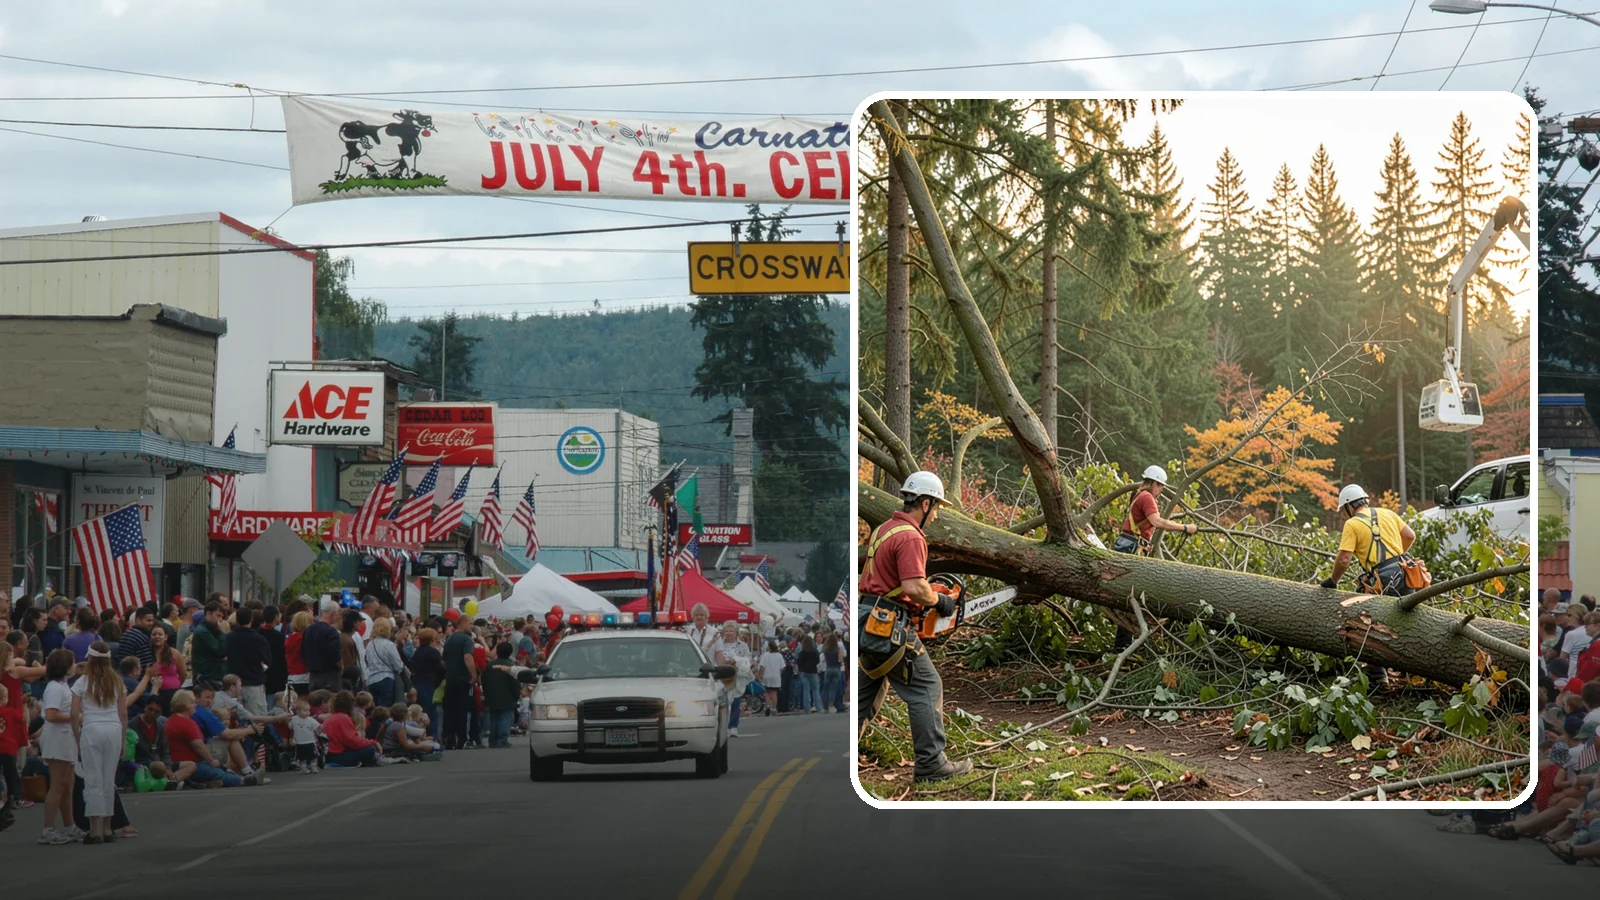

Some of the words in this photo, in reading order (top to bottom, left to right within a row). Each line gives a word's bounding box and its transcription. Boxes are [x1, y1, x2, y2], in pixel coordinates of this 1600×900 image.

[481, 141, 605, 192] JULY
[632, 150, 746, 197] 4th.
[697, 254, 850, 280] CROSSWA
[283, 380, 373, 420] ACE
[406, 409, 452, 422] CEDAR
[283, 421, 371, 437] Hardware
[354, 467, 386, 480] Simpl
[96, 485, 124, 494] Vincent
[126, 486, 136, 495] de
[138, 486, 155, 495] Paul
[688, 526, 741, 535] CRNATION
[699, 535, 730, 543] GLASS
